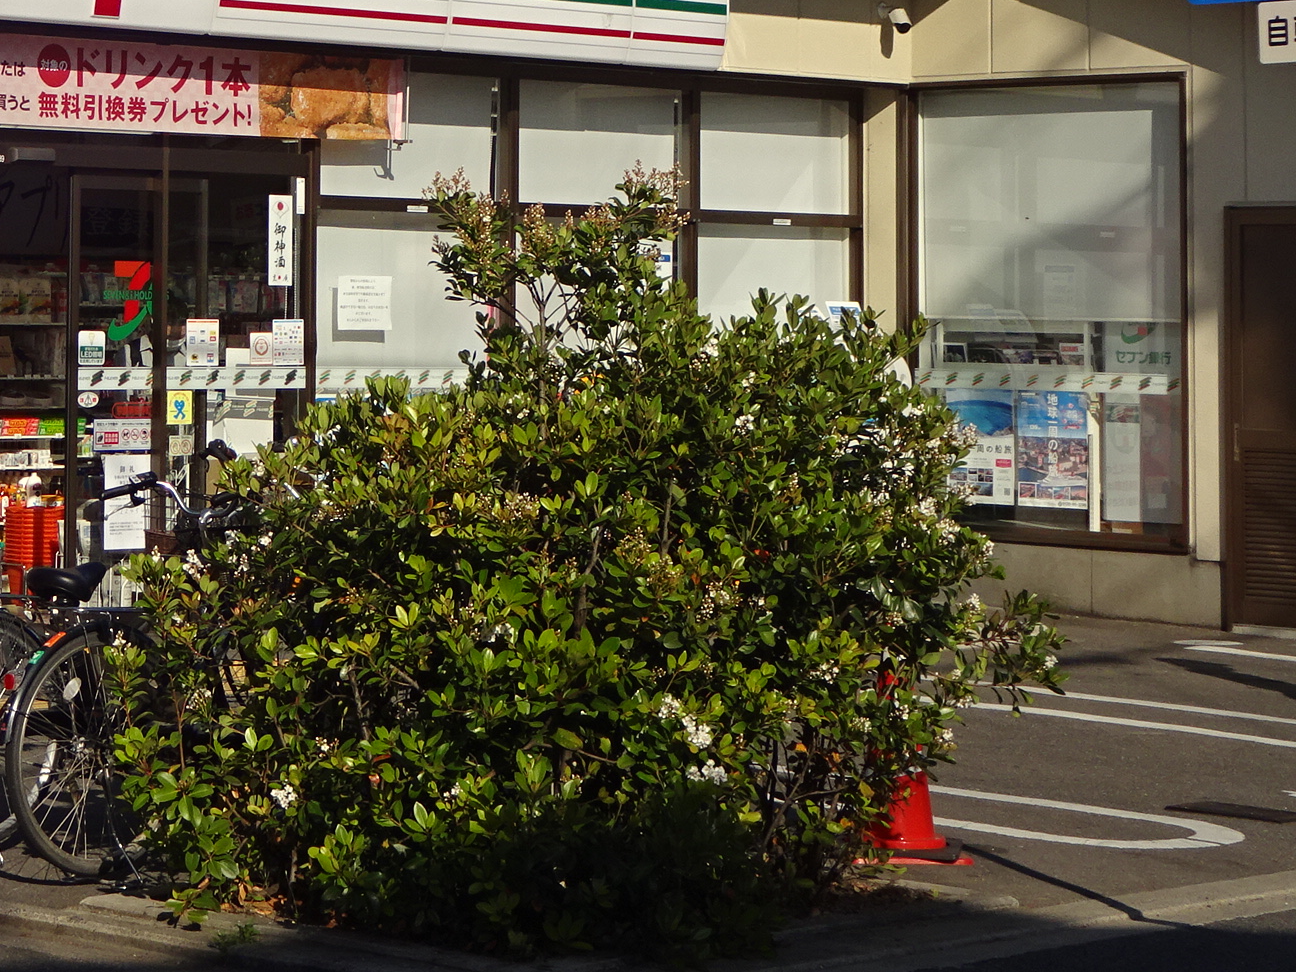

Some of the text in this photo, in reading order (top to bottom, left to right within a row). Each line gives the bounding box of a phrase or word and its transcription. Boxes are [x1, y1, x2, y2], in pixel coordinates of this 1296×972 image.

[1268, 15, 1296, 46] 自
[40, 58, 68, 71] 対象の
[76, 47, 251, 97] ドリンク1本
[1115, 350, 1172, 365] セブン銀行
